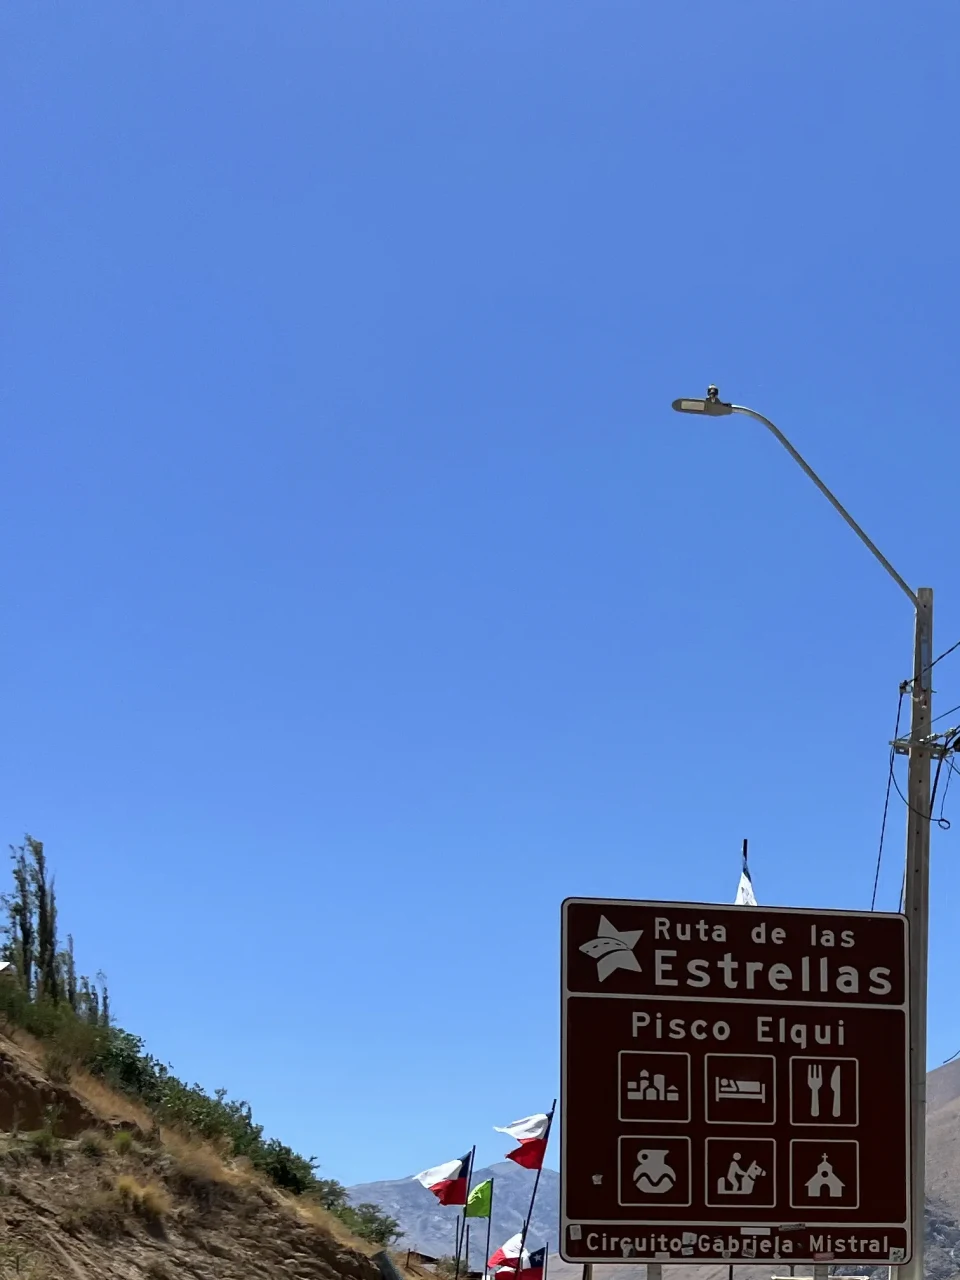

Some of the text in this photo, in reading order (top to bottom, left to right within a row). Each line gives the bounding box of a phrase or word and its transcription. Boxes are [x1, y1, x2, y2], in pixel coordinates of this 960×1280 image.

[654, 917, 856, 948] Ruta de las
[654, 949, 892, 996] Estrellas
[632, 1011, 845, 1050] Pisco Elqui
[586, 1232, 888, 1253] Circuito Gabriela Mistral
